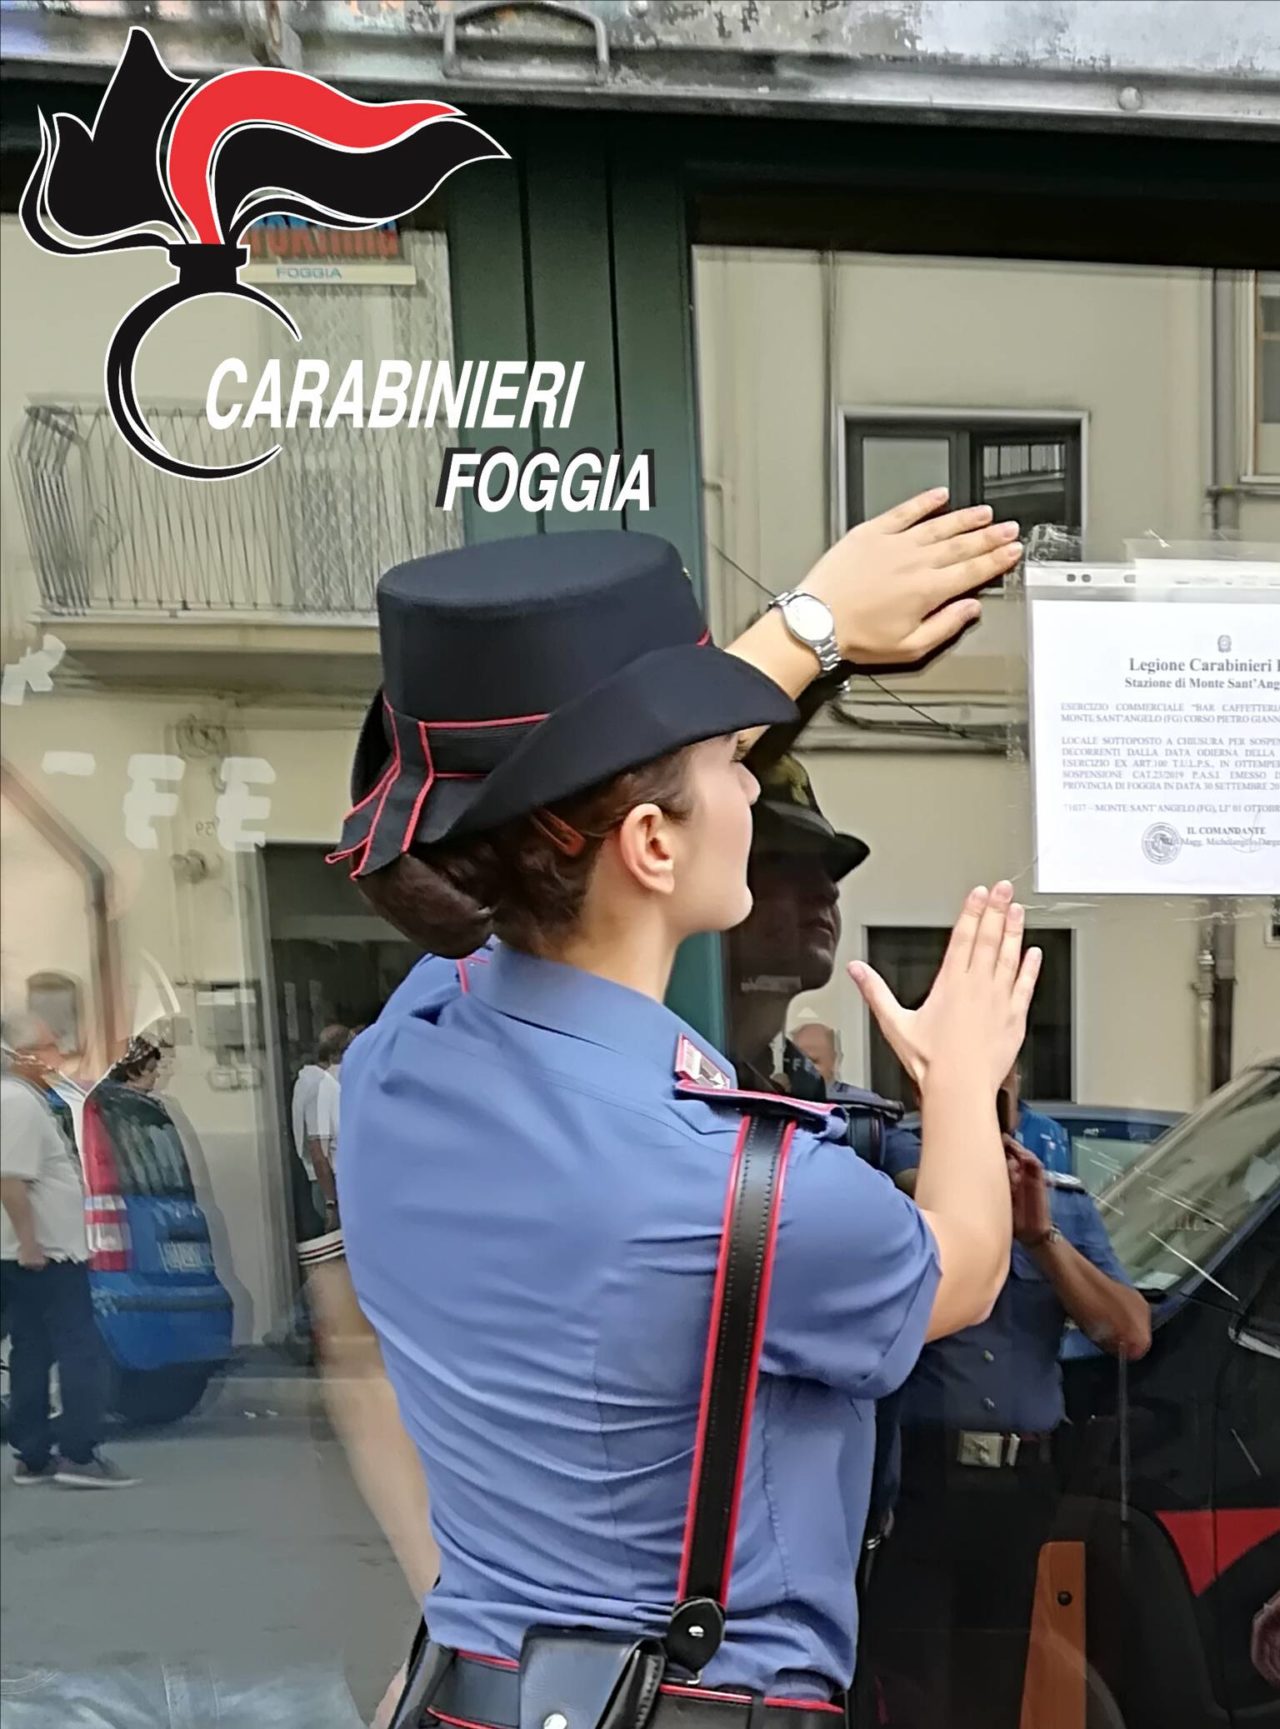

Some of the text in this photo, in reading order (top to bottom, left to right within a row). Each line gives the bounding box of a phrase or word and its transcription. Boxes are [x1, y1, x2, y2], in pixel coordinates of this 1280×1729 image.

[1129, 657, 1186, 675] Legione
[1189, 657, 1272, 672] Carabinieri
[1125, 678, 1172, 689] Stazione
[1175, 678, 1186, 689] di
[1189, 678, 1225, 690] Monte
[1187, 826, 1266, 835] IL COMANDANTE
